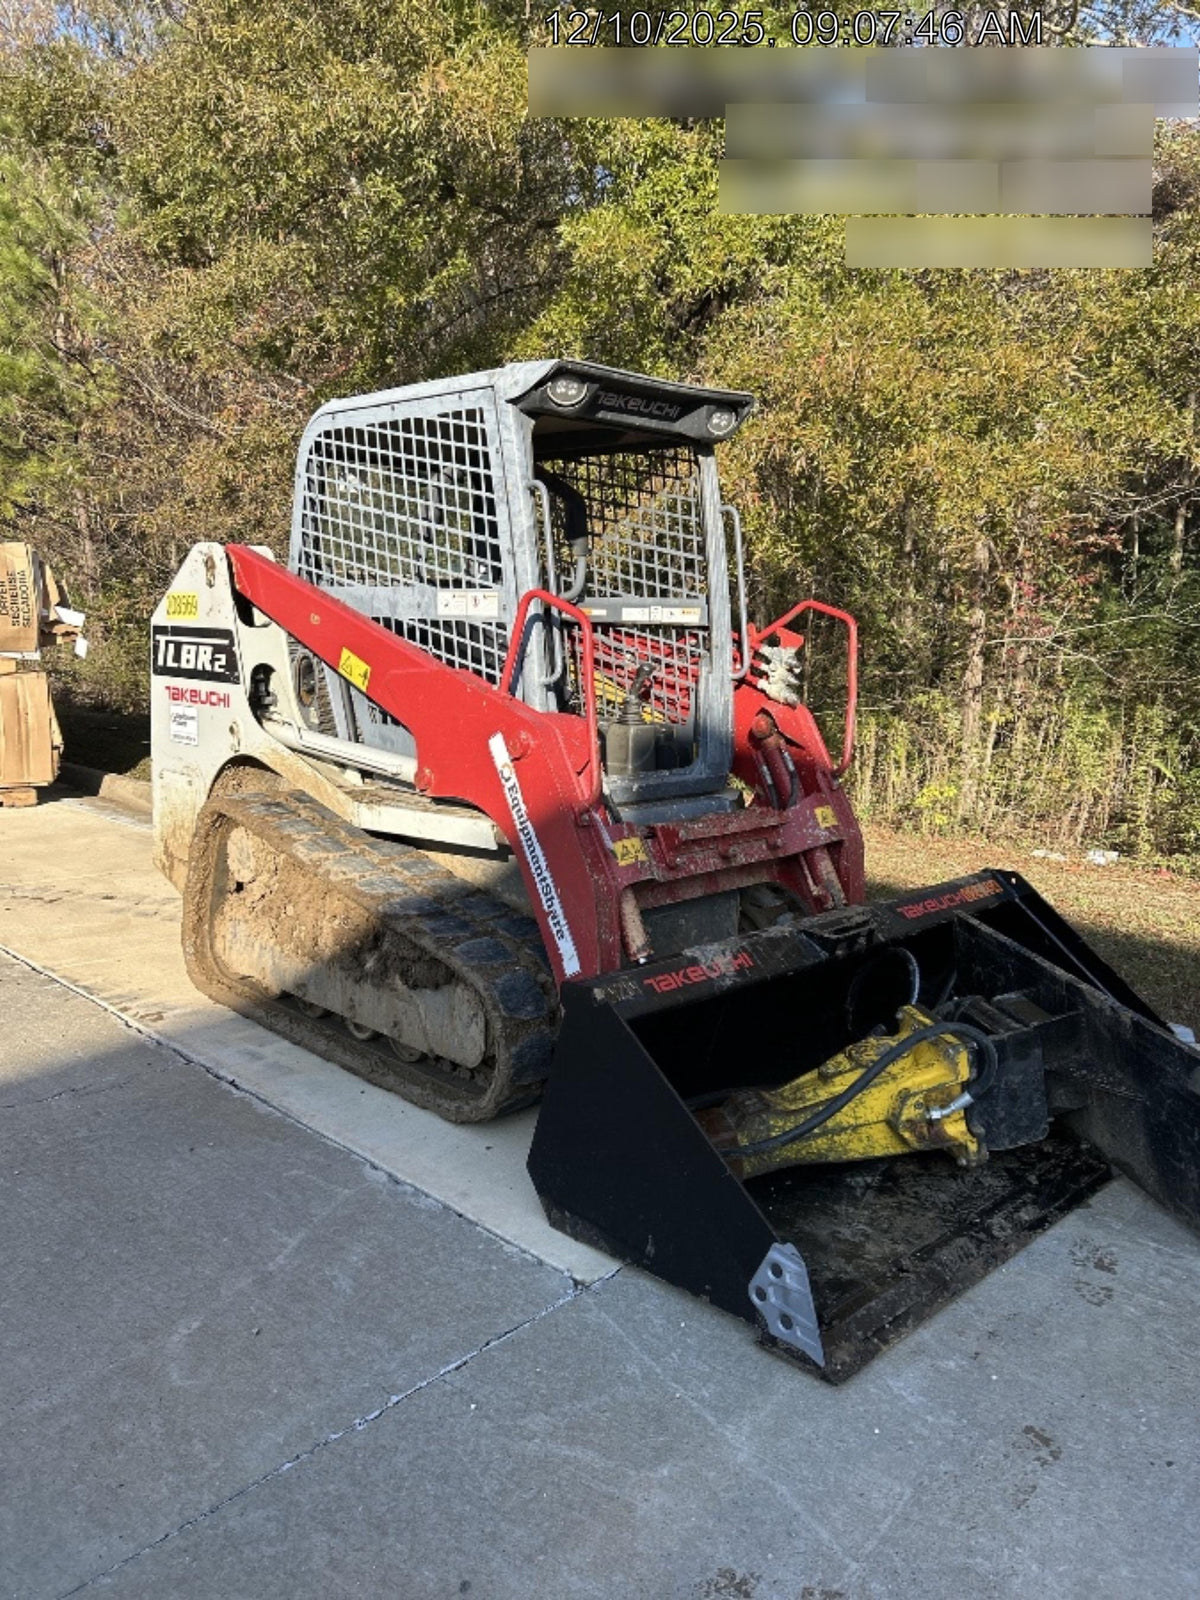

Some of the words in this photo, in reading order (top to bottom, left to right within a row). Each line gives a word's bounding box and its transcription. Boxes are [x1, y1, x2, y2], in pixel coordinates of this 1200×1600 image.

[597, 391, 681, 418] TAKEUCHI
[164, 685, 230, 708] TAKEUCHI
[507, 781, 566, 942] EquipmentShare
[896, 891, 968, 919] TAKEUCHI
